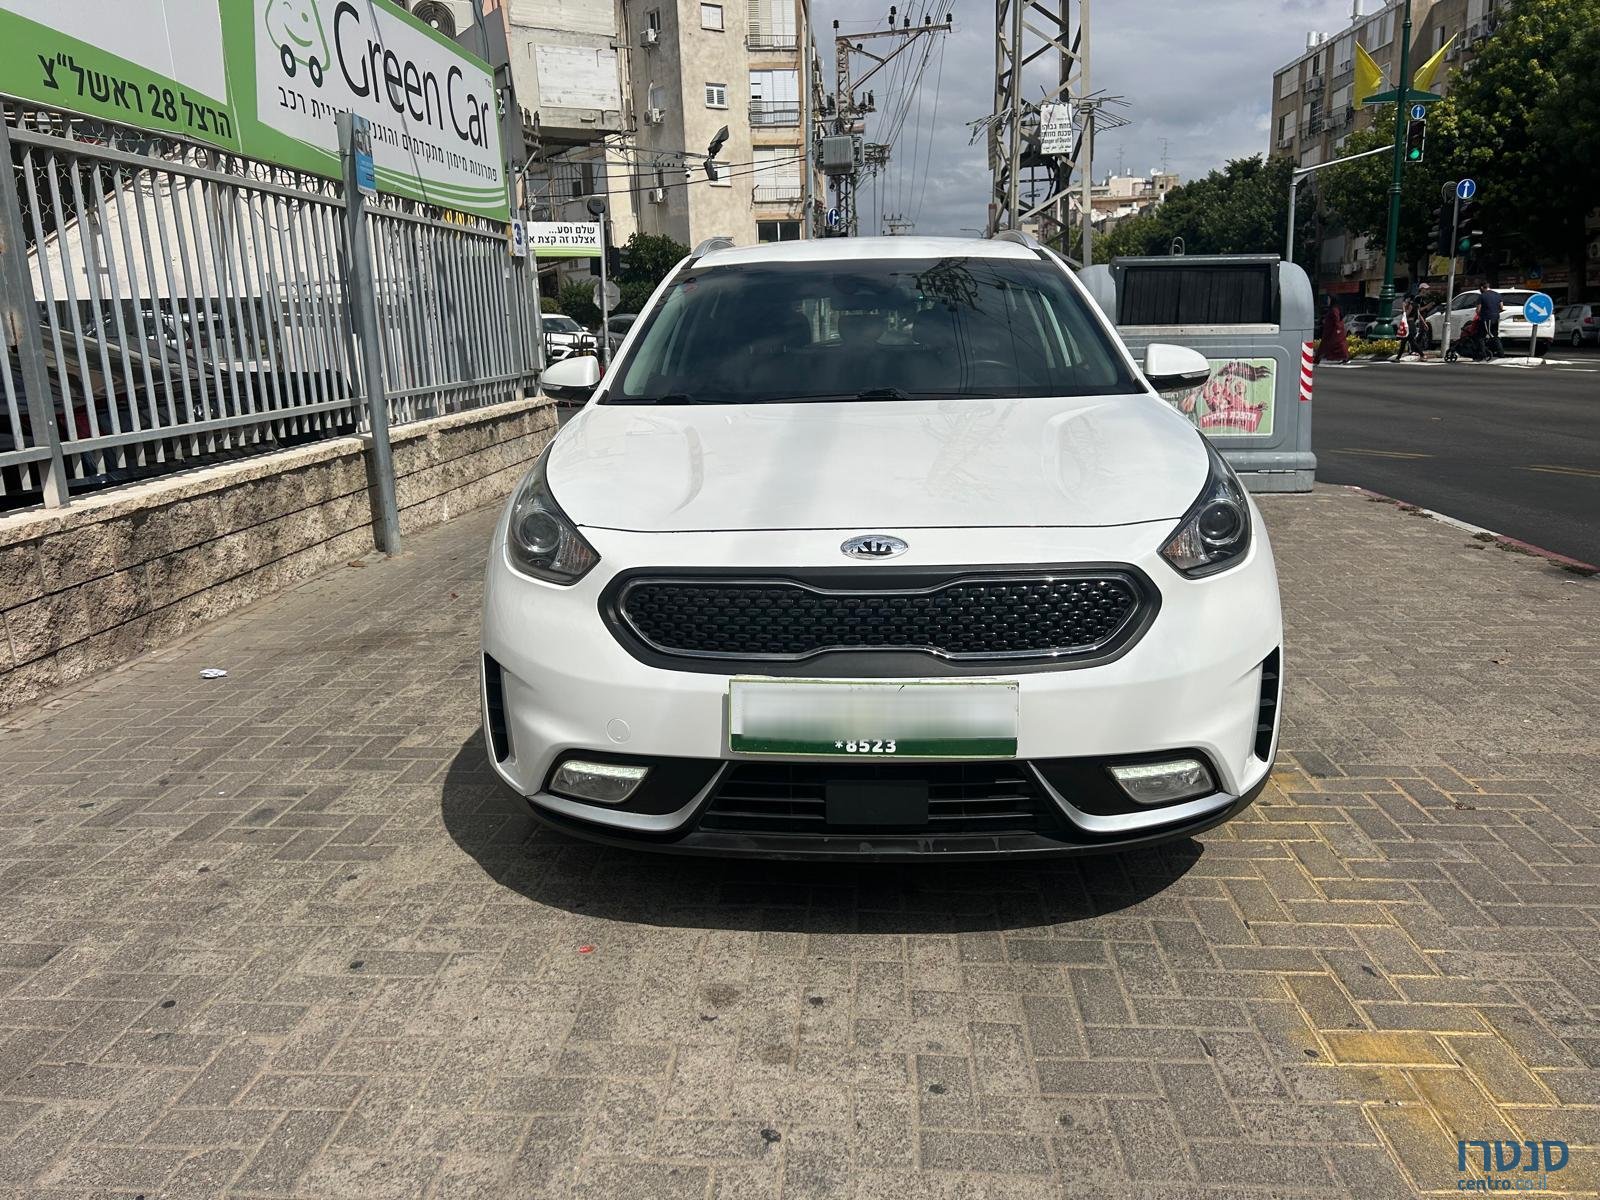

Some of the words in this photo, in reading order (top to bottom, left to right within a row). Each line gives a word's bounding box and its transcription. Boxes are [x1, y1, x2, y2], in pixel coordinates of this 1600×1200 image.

[333, 1, 444, 131] Green
[447, 65, 489, 150] Car
[147, 83, 178, 122] 28
[278, 86, 306, 114] רכב
[180, 92, 232, 138] הרצל
[368, 121, 399, 147] והוגני
[402, 133, 444, 164] מתקדמים
[446, 151, 468, 172] מימון
[469, 159, 498, 182] פתרונות
[537, 236, 556, 245] קצת
[559, 236, 569, 244] זה
[572, 235, 596, 244] אצלנו
[575, 225, 595, 234] שלם
